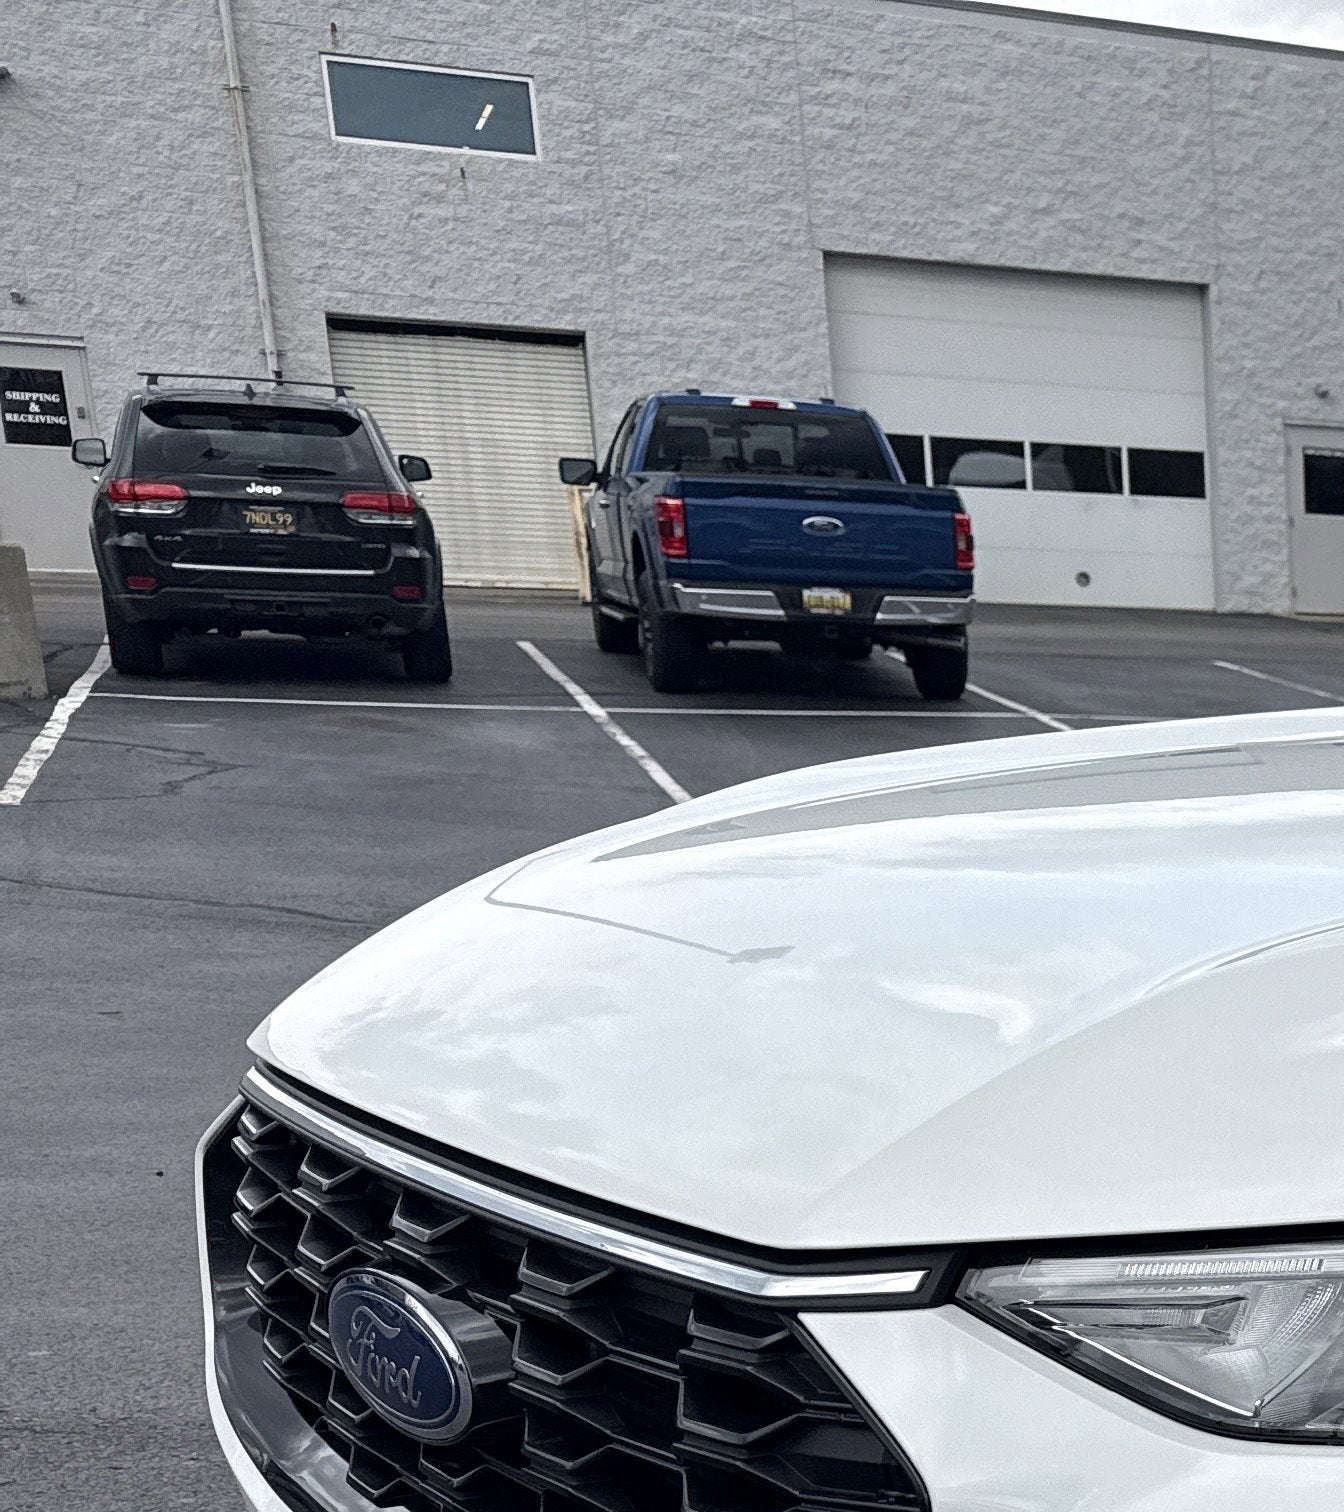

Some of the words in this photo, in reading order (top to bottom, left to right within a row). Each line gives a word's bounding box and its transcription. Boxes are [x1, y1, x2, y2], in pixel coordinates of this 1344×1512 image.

[5, 391, 60, 403] SHIPPING
[29, 401, 41, 412] &
[5, 413, 68, 425] RECEIVING
[246, 482, 282, 496] Jeep
[346, 1305, 421, 1408] Ford
